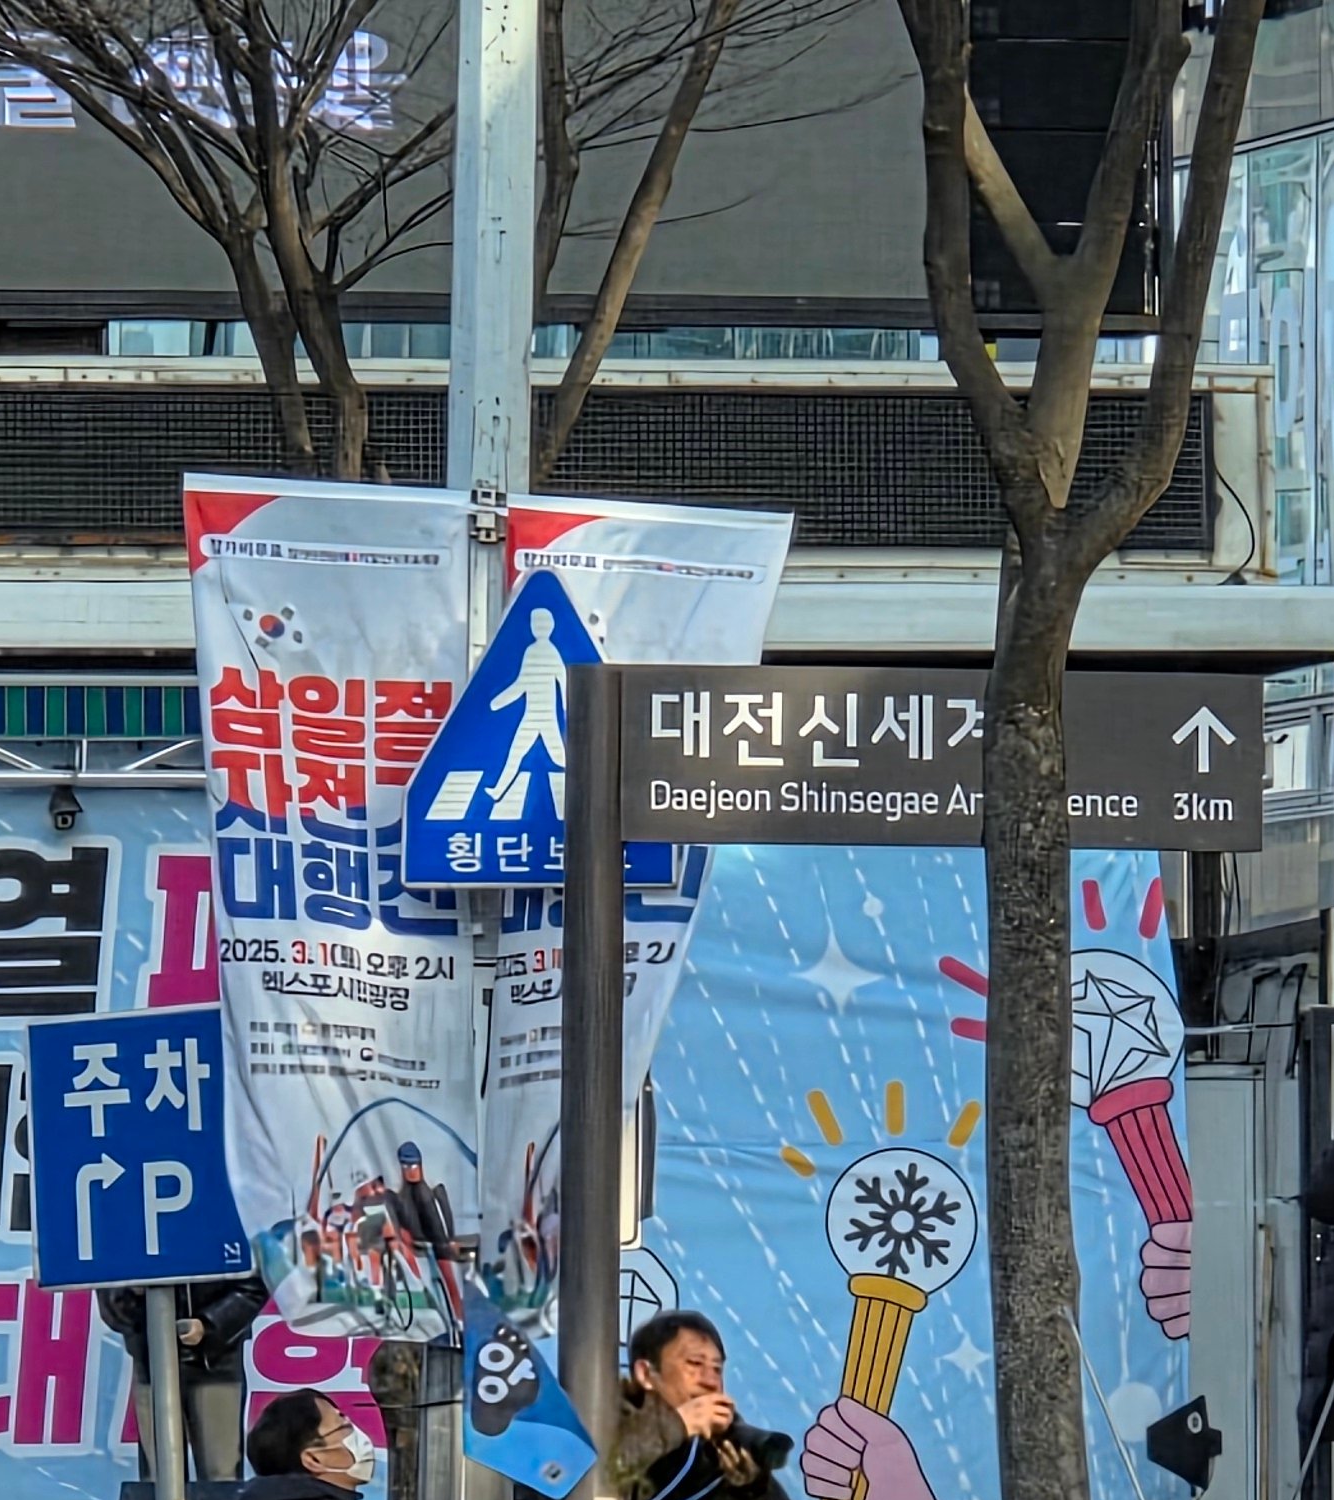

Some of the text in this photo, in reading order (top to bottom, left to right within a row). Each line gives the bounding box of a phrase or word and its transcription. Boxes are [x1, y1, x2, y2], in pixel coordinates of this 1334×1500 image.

[651, 779, 772, 819] Daejeon
[780, 783, 939, 822] Shinsegae
[1173, 790, 1235, 822] 3km
[414, 956, 455, 981] 2시
[63, 1036, 212, 1138] 주차
[144, 1159, 195, 1257] P
